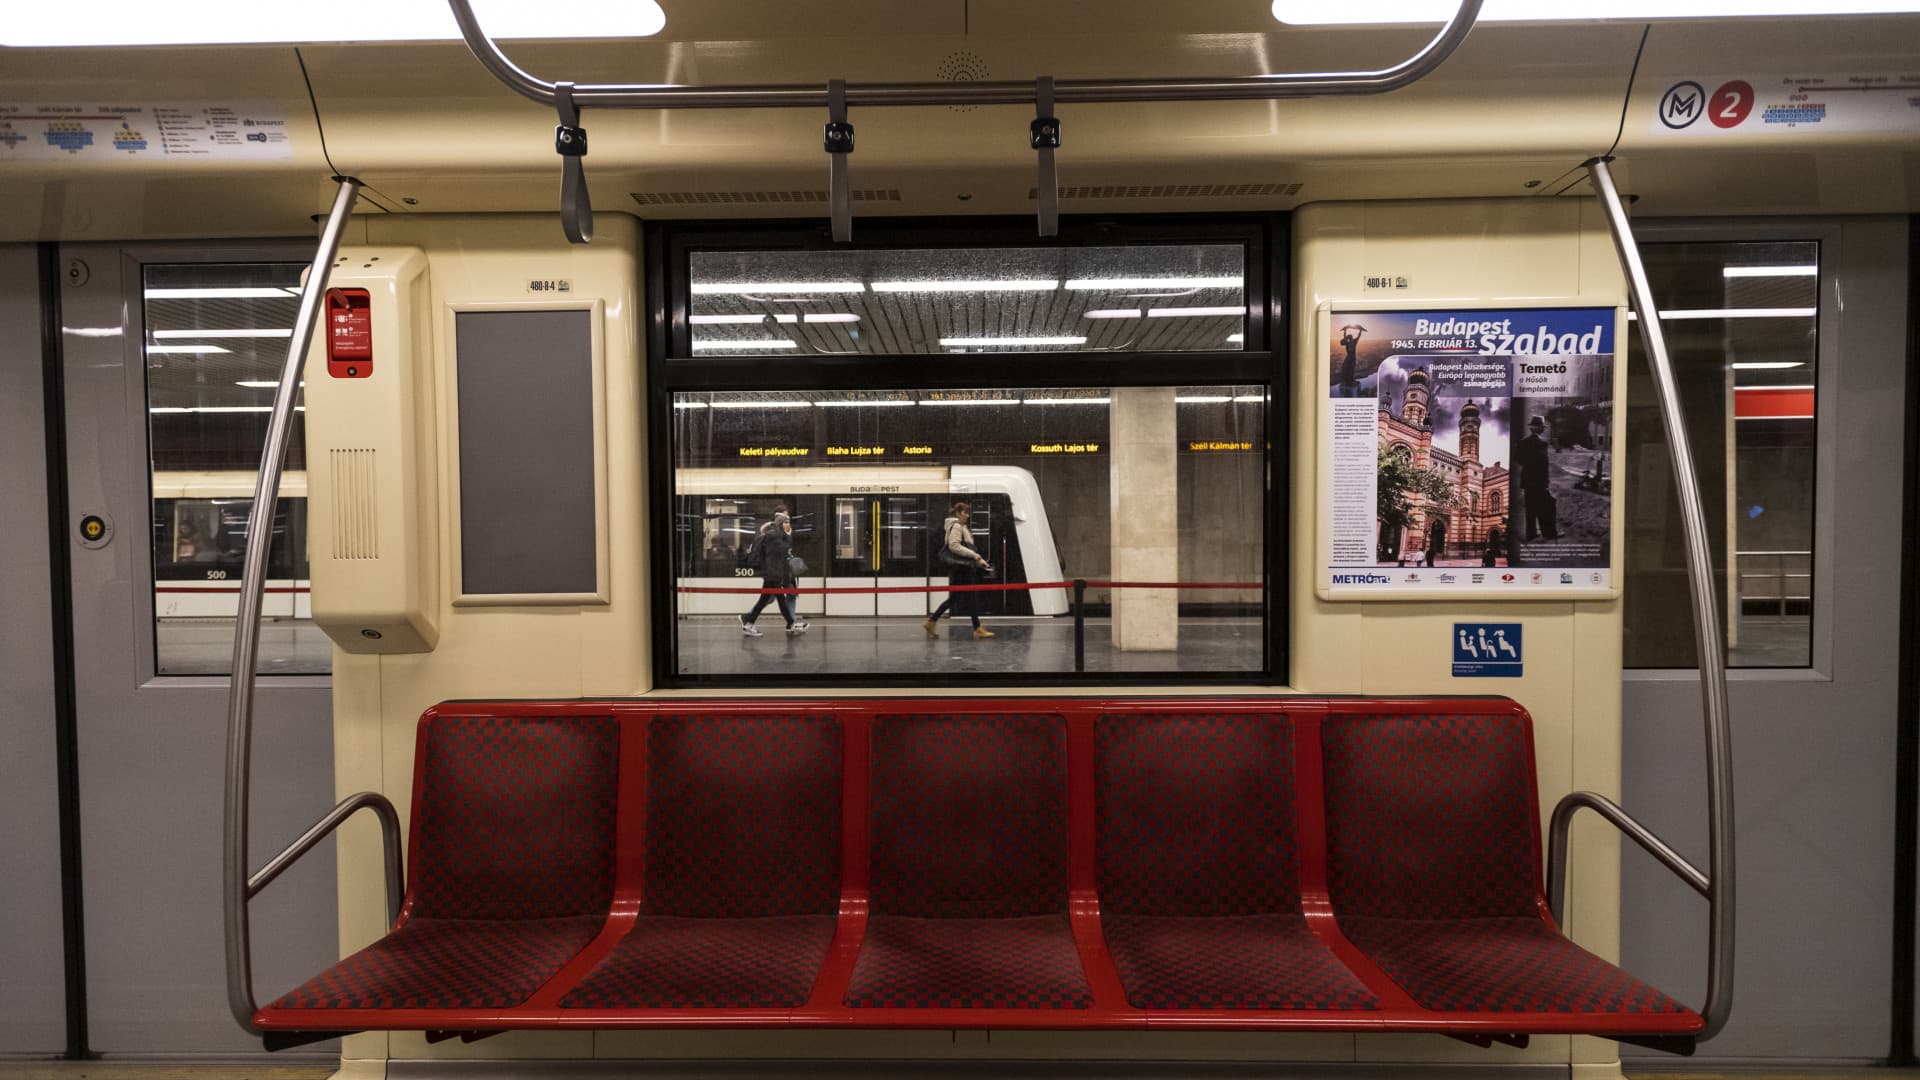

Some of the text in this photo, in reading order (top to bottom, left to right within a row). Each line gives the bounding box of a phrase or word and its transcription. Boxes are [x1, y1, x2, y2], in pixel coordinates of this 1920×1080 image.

[1719, 92, 1741, 119] 2
[1415, 317, 1511, 340] Budapest
[1391, 337, 1478, 349] 1945. FEBRUÁR 13.
[1429, 363, 1462, 371] Budapest
[1519, 361, 1567, 374] Temető
[740, 447, 809, 457] Keleti pályaudvar
[850, 447, 872, 456] Lujza
[872, 446, 885, 455] tér
[903, 446, 933, 455] Astoria
[1031, 442, 1099, 454] Kossuth Lajos tér
[207, 570, 226, 579] 500
[735, 568, 754, 577] 500
